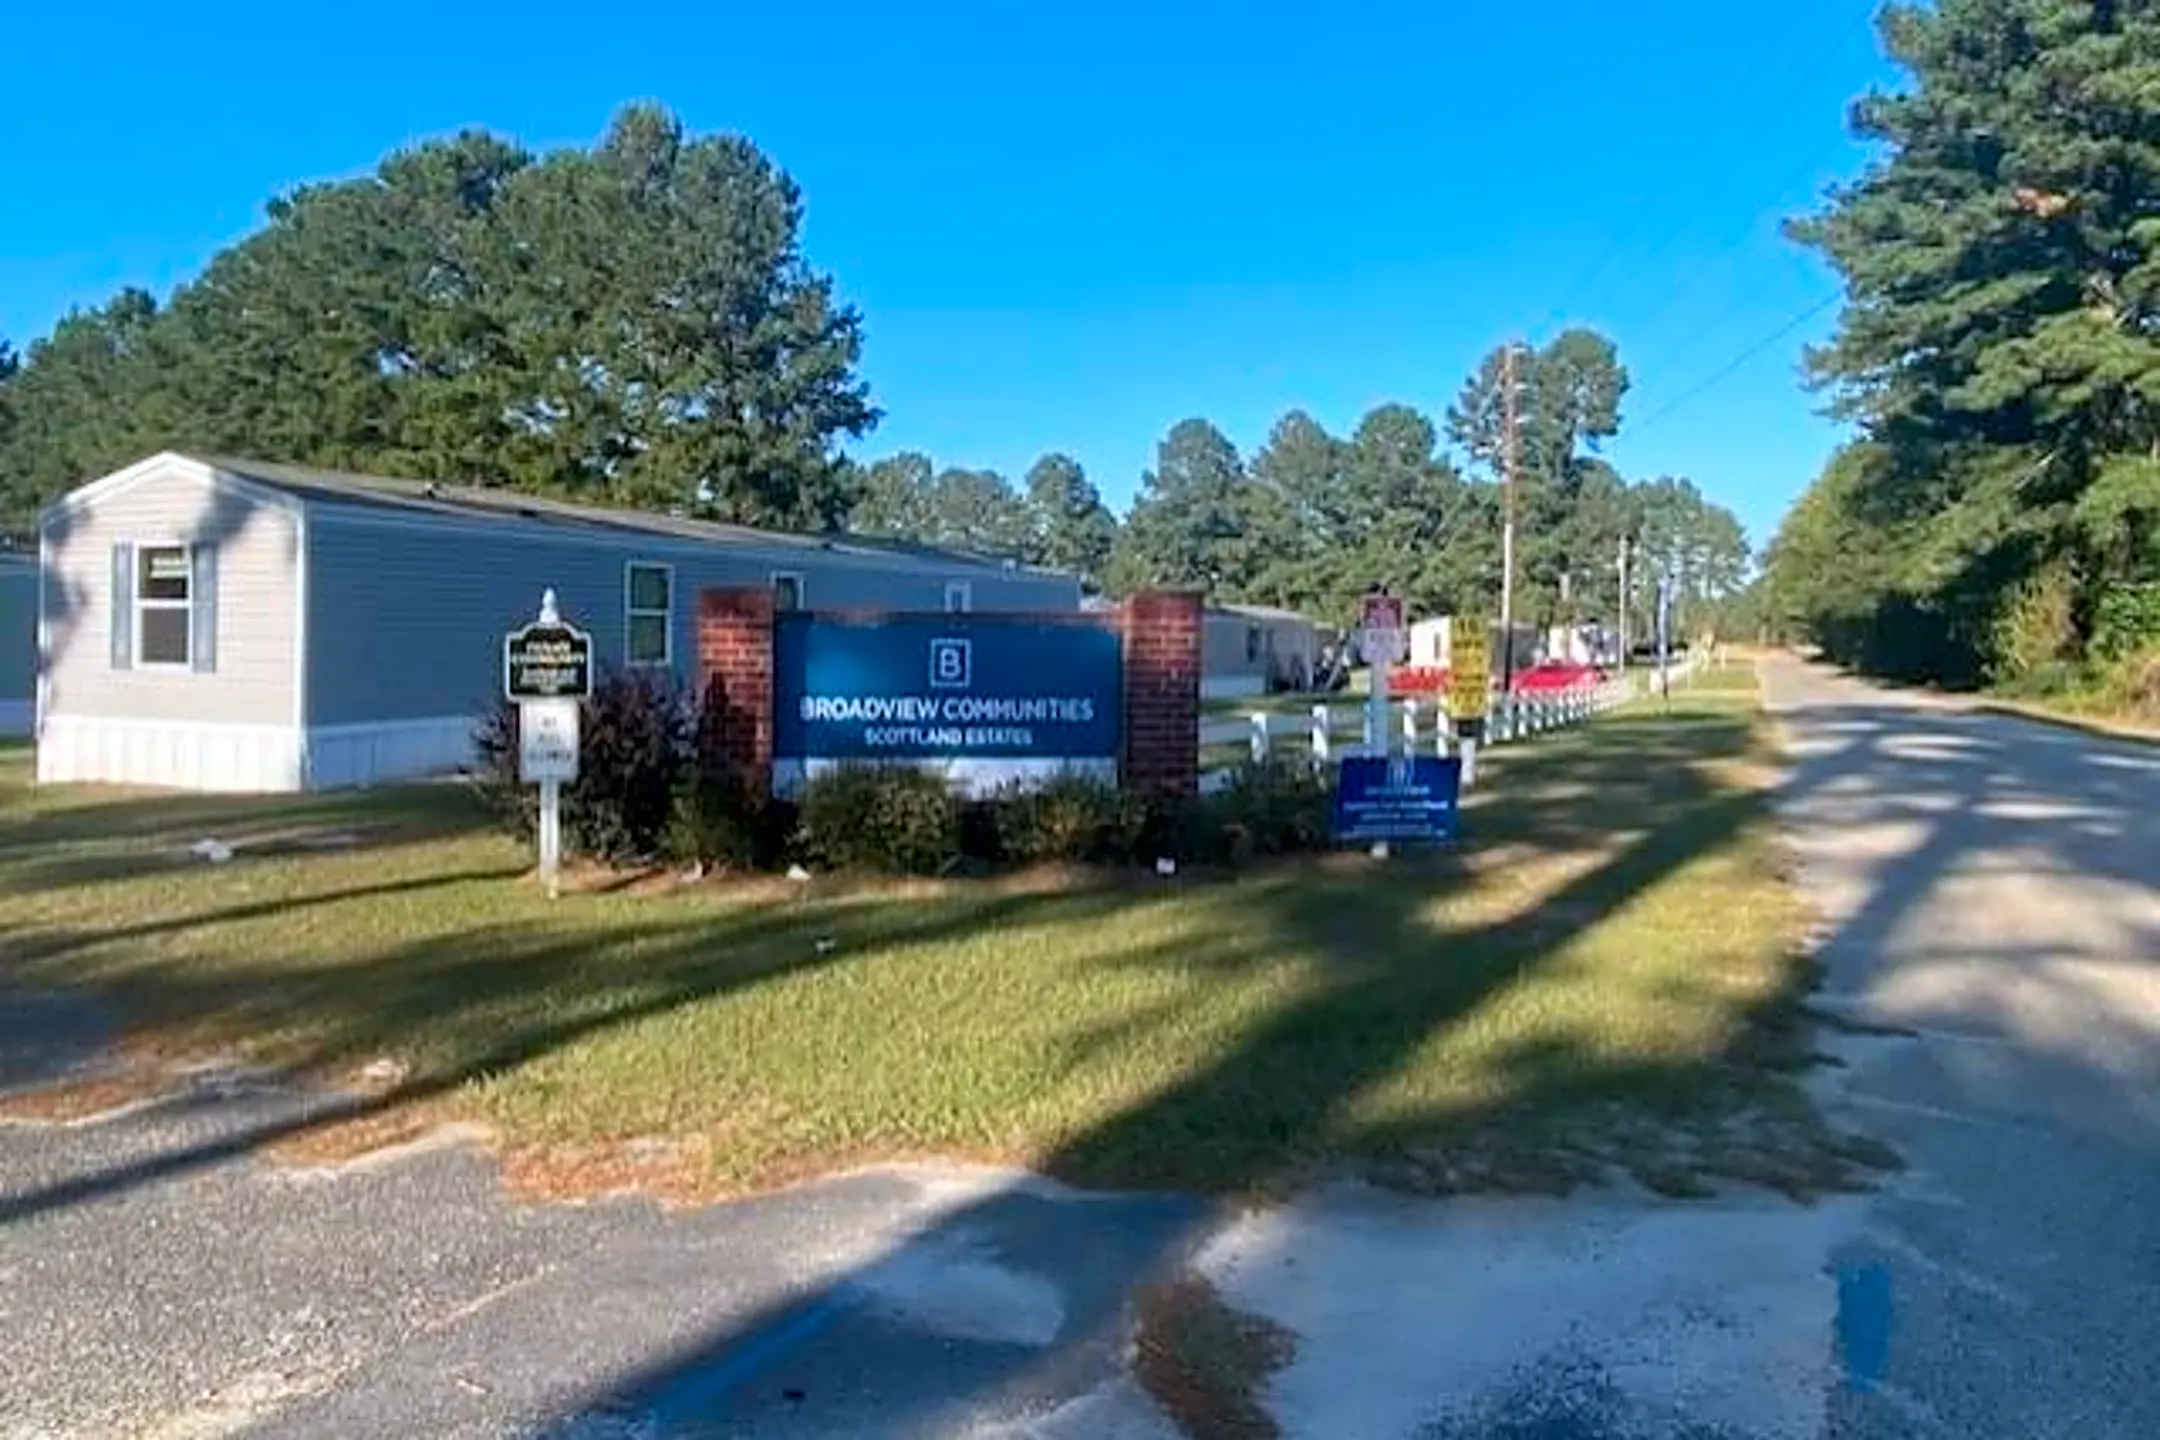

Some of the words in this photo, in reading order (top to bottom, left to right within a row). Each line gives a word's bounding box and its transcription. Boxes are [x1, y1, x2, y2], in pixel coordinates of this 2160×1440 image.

[940, 648, 961, 678] B
[801, 697, 938, 721] BROADVIEW
[942, 697, 1094, 721] COMMUNITIES
[865, 727, 962, 745] SCOTTLAND
[966, 727, 1033, 745] ESTATES
